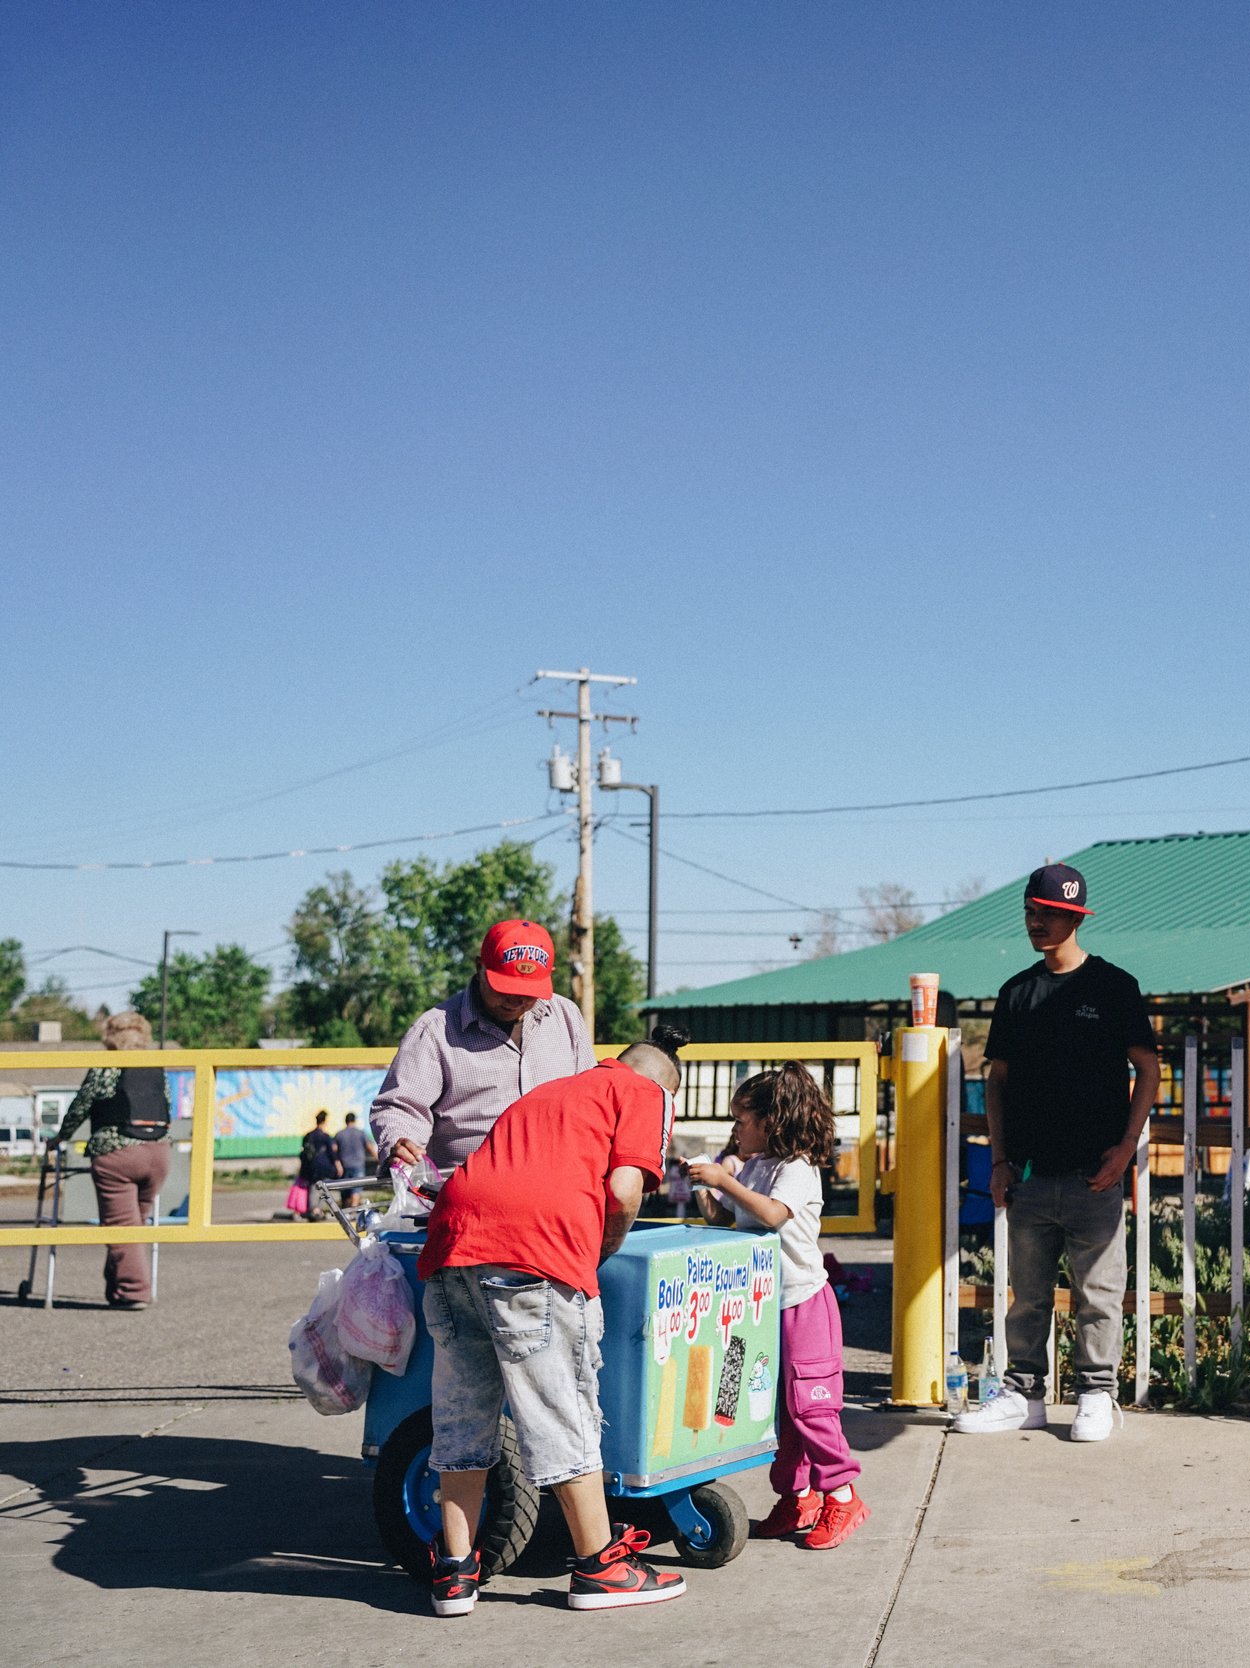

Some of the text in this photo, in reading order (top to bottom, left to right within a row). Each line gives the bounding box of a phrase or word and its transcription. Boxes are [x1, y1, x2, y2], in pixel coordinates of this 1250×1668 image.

[1062, 881, 1079, 899] W
[502, 945, 549, 968] NEW YORK
[688, 1255, 713, 1285] Paleta
[753, 1247, 773, 1272] Nieve
[716, 1259, 750, 1296] Esquimal
[658, 1279, 684, 1310] Bolis
